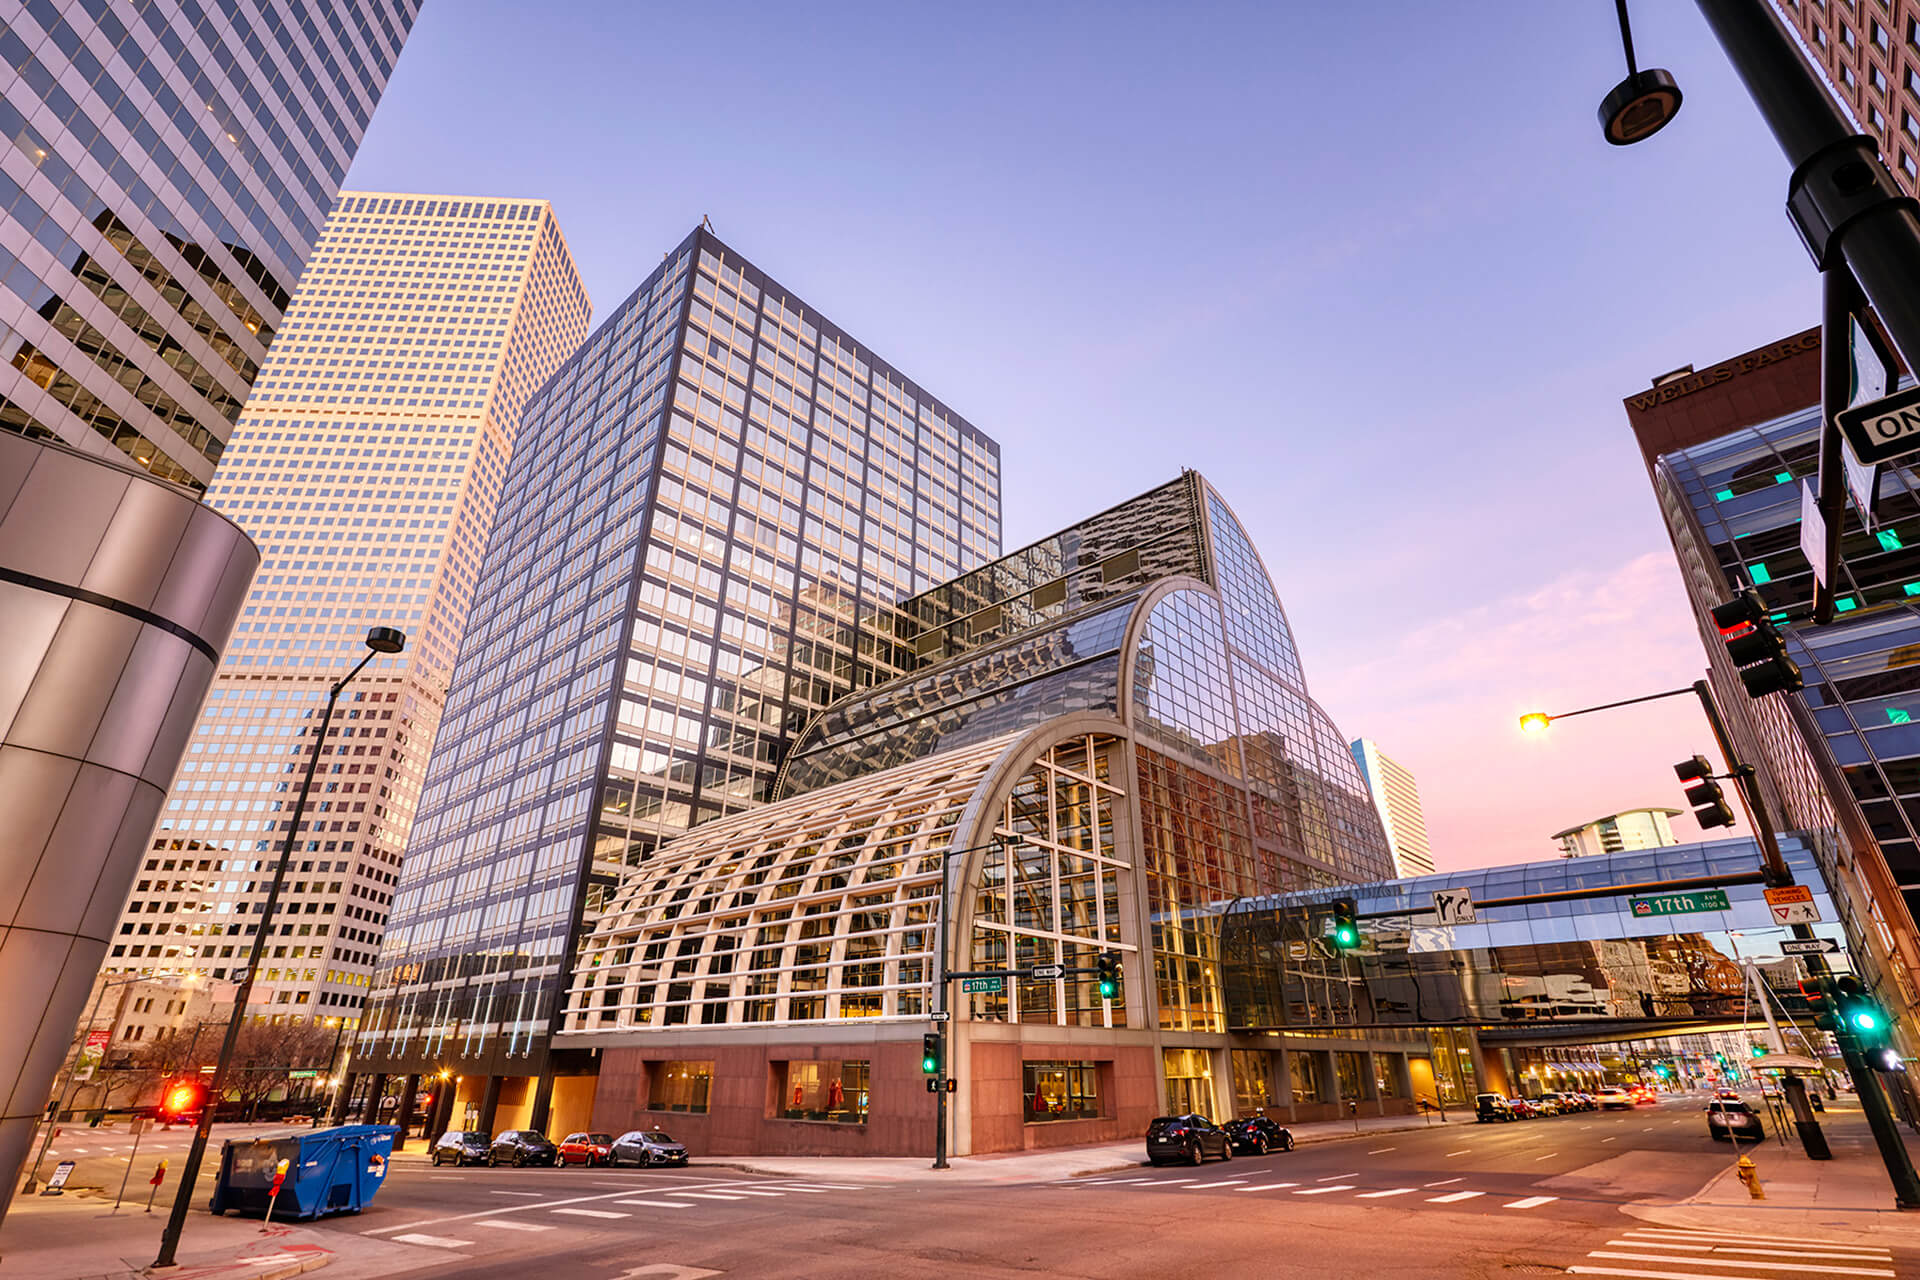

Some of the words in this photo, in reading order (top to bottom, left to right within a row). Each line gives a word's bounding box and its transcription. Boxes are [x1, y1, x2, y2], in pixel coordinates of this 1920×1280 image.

[1629, 366, 1733, 412] WELLS
[1734, 334, 1822, 376] FARG
[1876, 403, 1920, 438] ON
[1772, 887, 1802, 896] TURNING
[1773, 894, 1807, 902] VEHICLES
[1654, 896, 1695, 912] 17th
[972, 980, 988, 990] 17th
